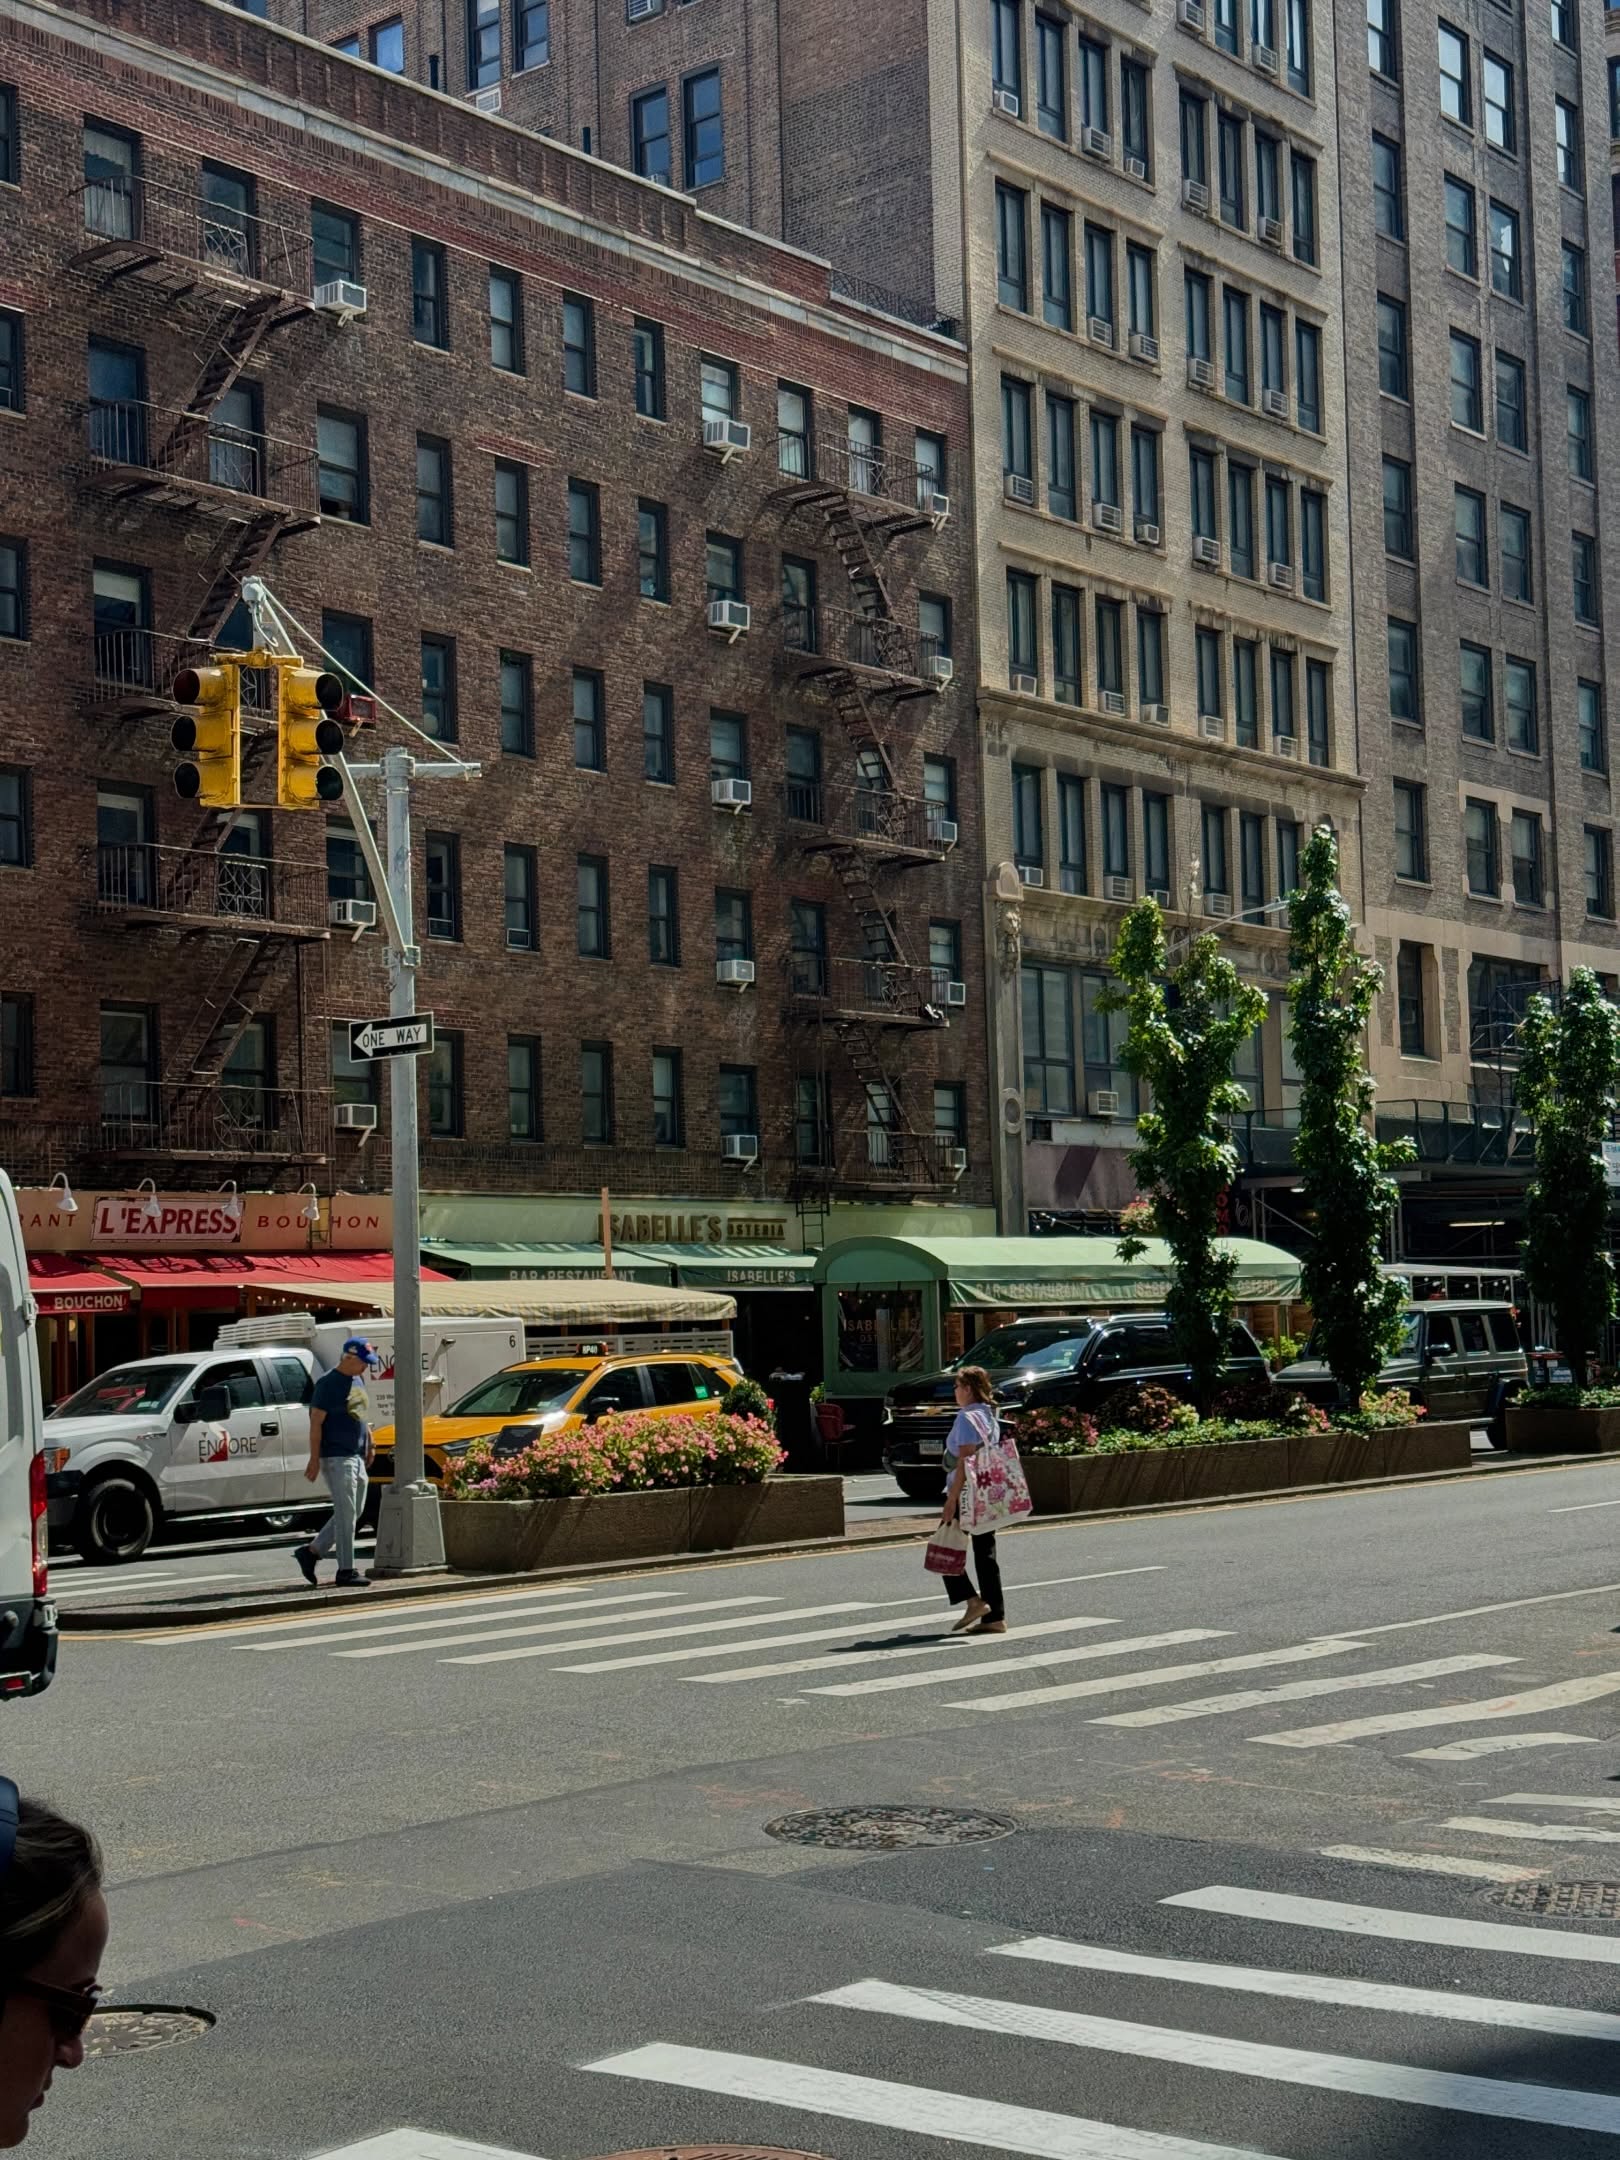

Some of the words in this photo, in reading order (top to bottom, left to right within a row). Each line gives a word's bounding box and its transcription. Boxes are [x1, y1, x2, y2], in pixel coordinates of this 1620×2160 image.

[362, 1031, 385, 1048] ONE
[396, 1027, 421, 1043] WAY
[100, 1207, 237, 1234] L'EXPRESS
[257, 1215, 380, 1228] BOUHON
[726, 1223, 785, 1236] OSTERIA
[727, 1270, 796, 1283] ISABELLE'S
[54, 1294, 124, 1310] BOUCHON
[509, 1334, 516, 1348] 6
